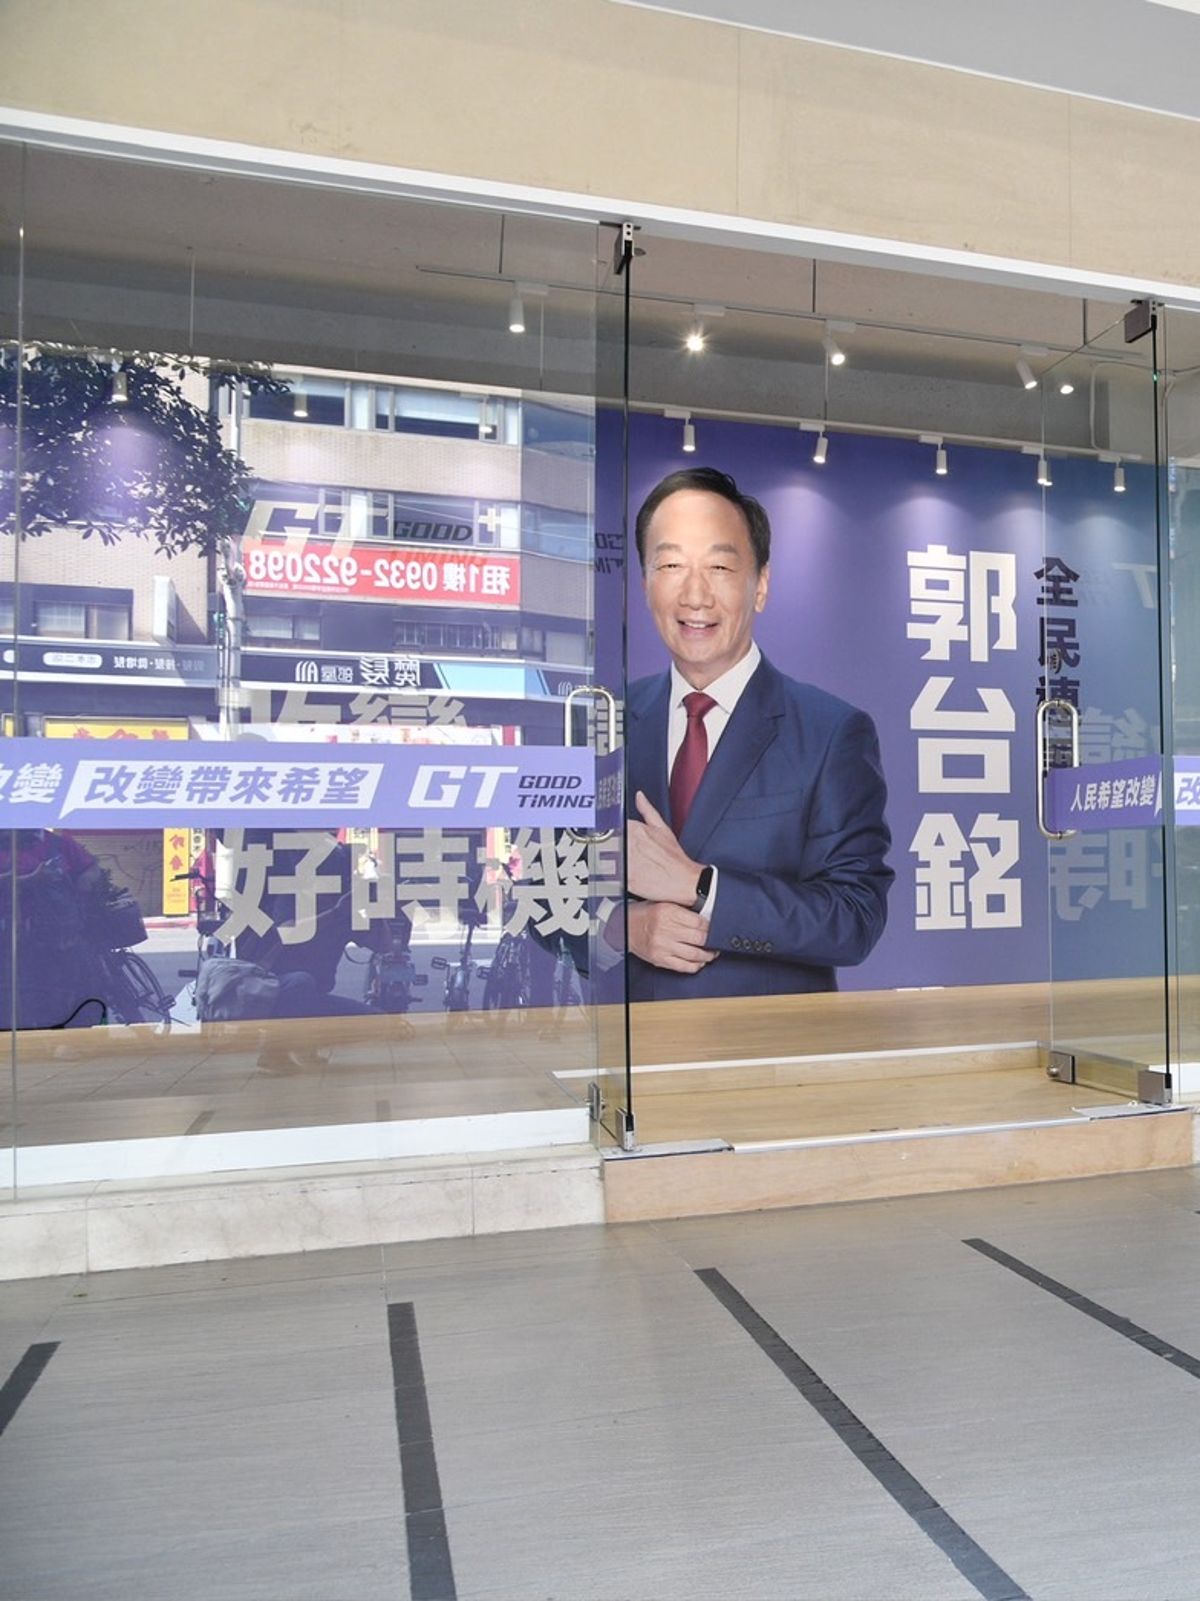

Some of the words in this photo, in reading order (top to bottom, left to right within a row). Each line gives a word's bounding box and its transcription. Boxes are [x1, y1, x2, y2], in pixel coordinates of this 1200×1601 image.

[906, 544, 1022, 931] 郭台銘
[84, 764, 370, 804] 改變帶來希望
[407, 765, 519, 809] GT
[518, 775, 582, 789] GOOD
[1070, 774, 1156, 812] 人民希望改變
[213, 828, 593, 946] 好時機
